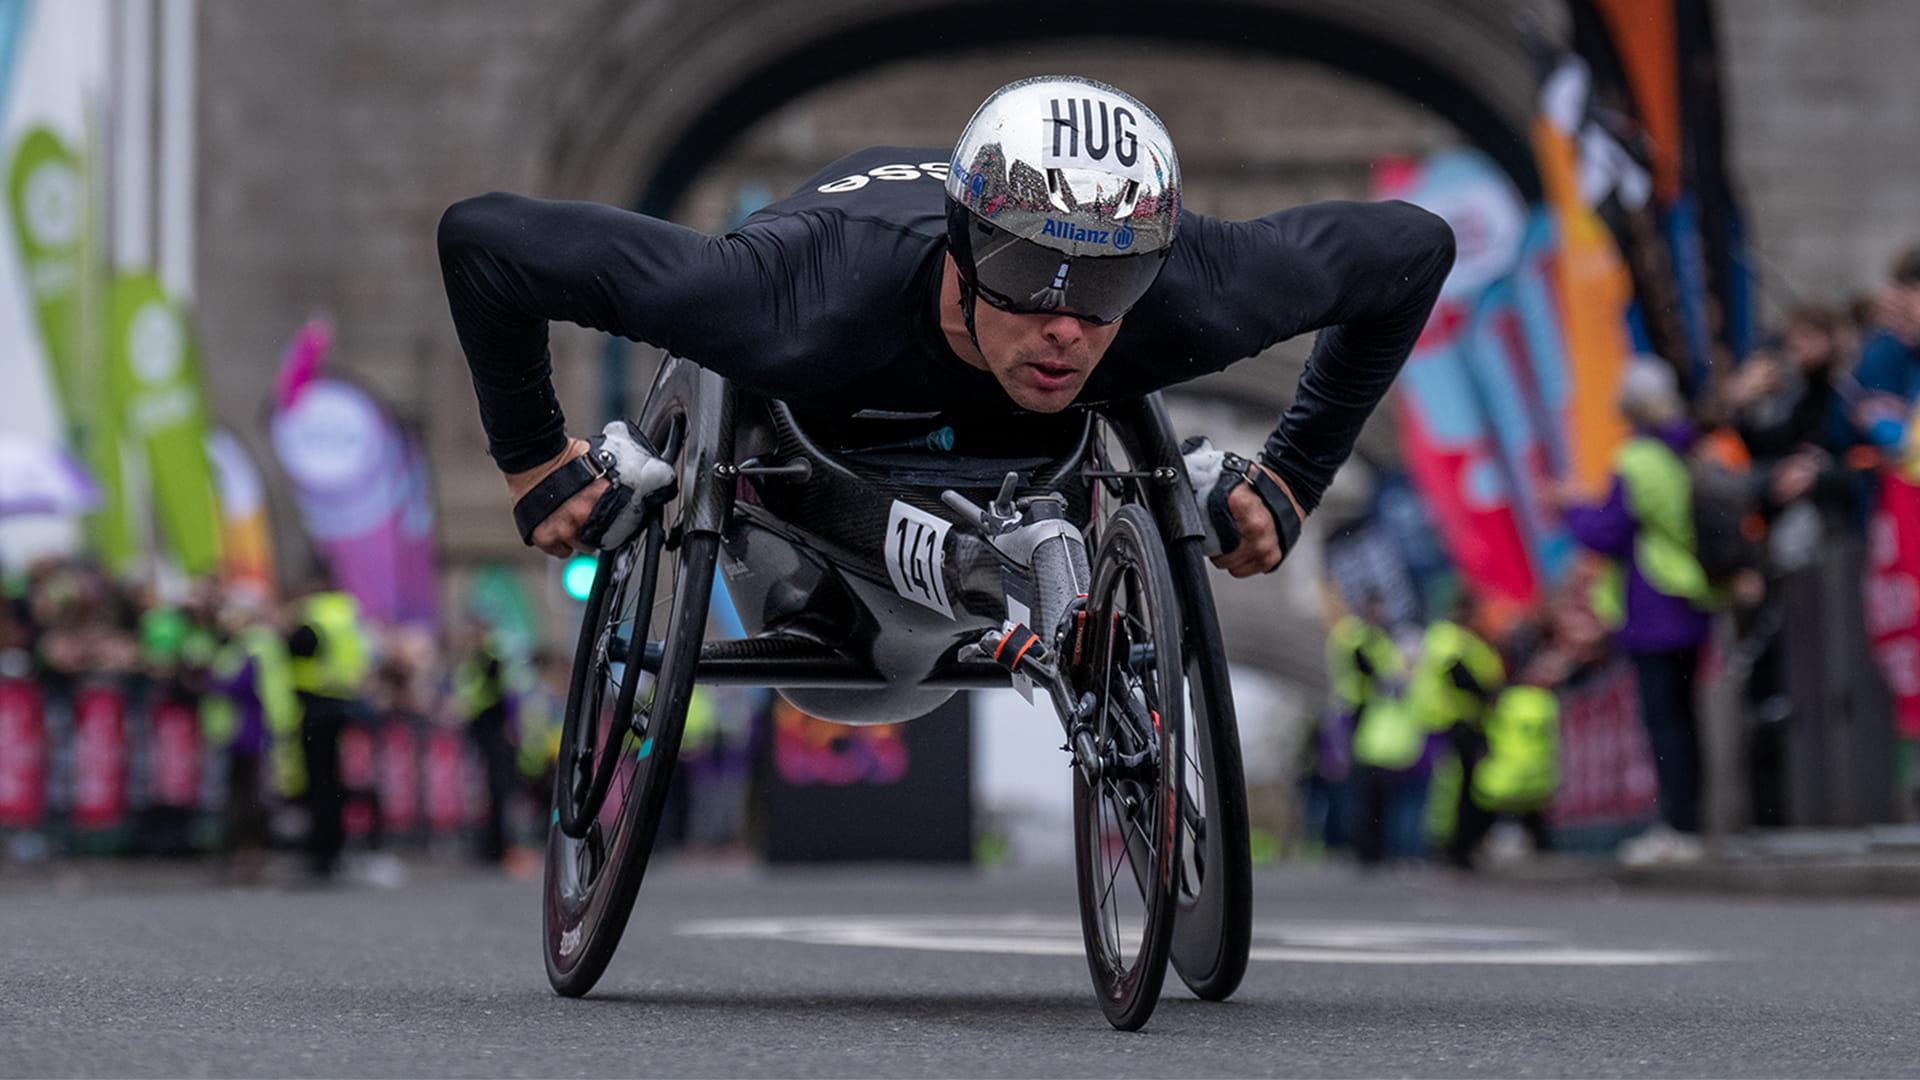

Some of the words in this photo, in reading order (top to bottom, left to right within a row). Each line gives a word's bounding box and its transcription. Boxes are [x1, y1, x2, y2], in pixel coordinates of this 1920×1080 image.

[1050, 98, 1138, 167] HUG
[1042, 218, 1109, 244] Allianz
[896, 517, 944, 607] 141
